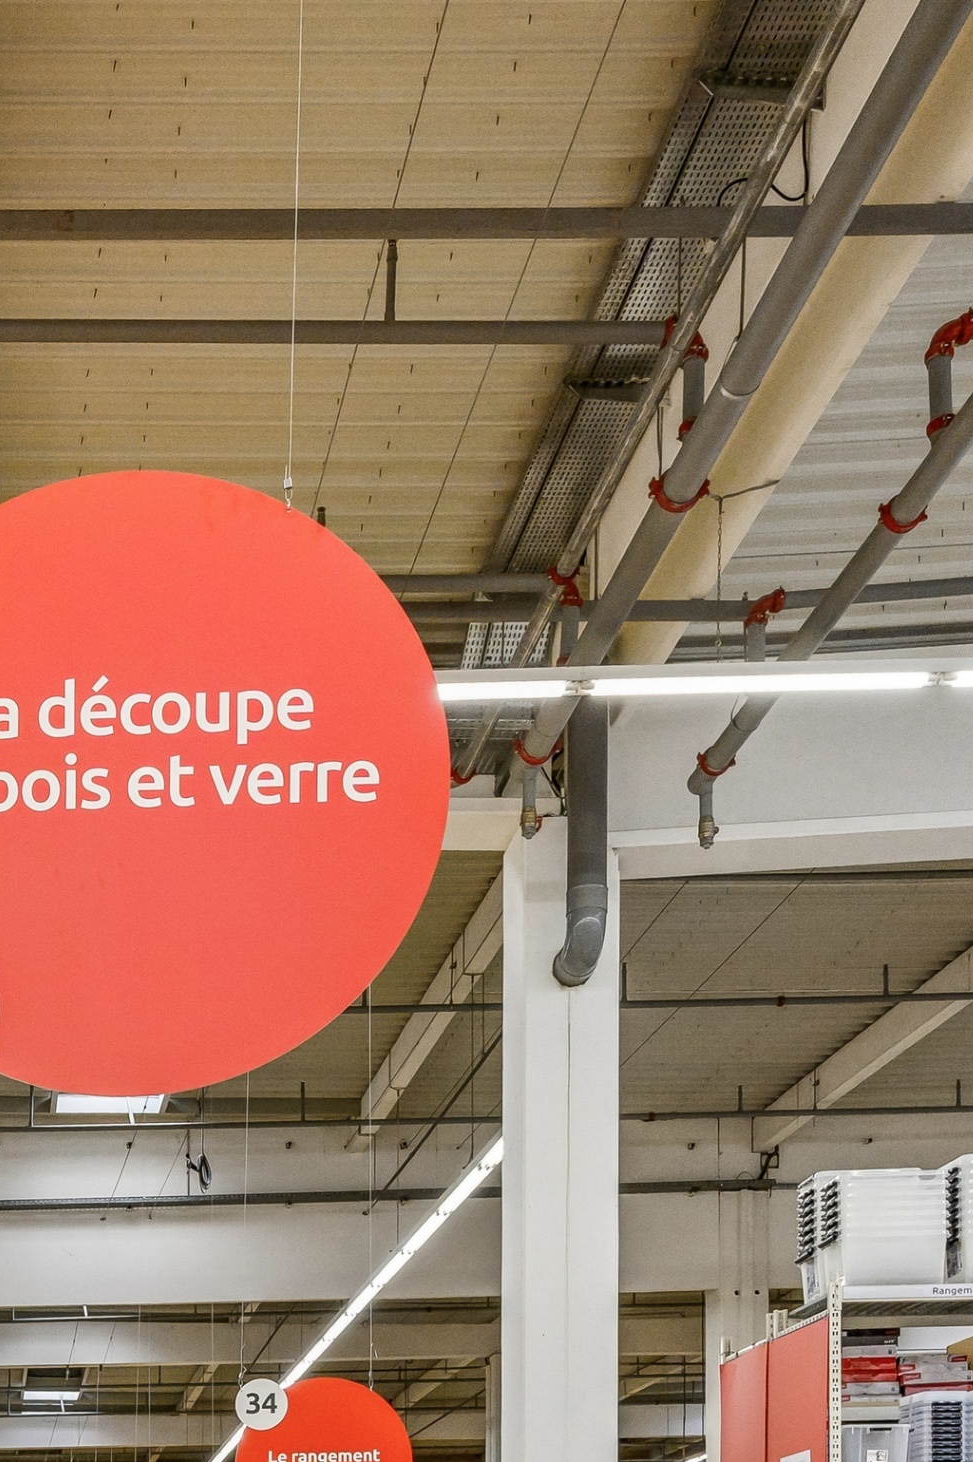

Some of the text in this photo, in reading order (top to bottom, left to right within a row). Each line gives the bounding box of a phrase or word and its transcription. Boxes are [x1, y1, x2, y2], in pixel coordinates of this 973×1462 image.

[37, 674, 315, 745] découpe
[127, 755, 196, 808] et
[210, 760, 381, 806] verre
[245, 1392, 278, 1415] 34
